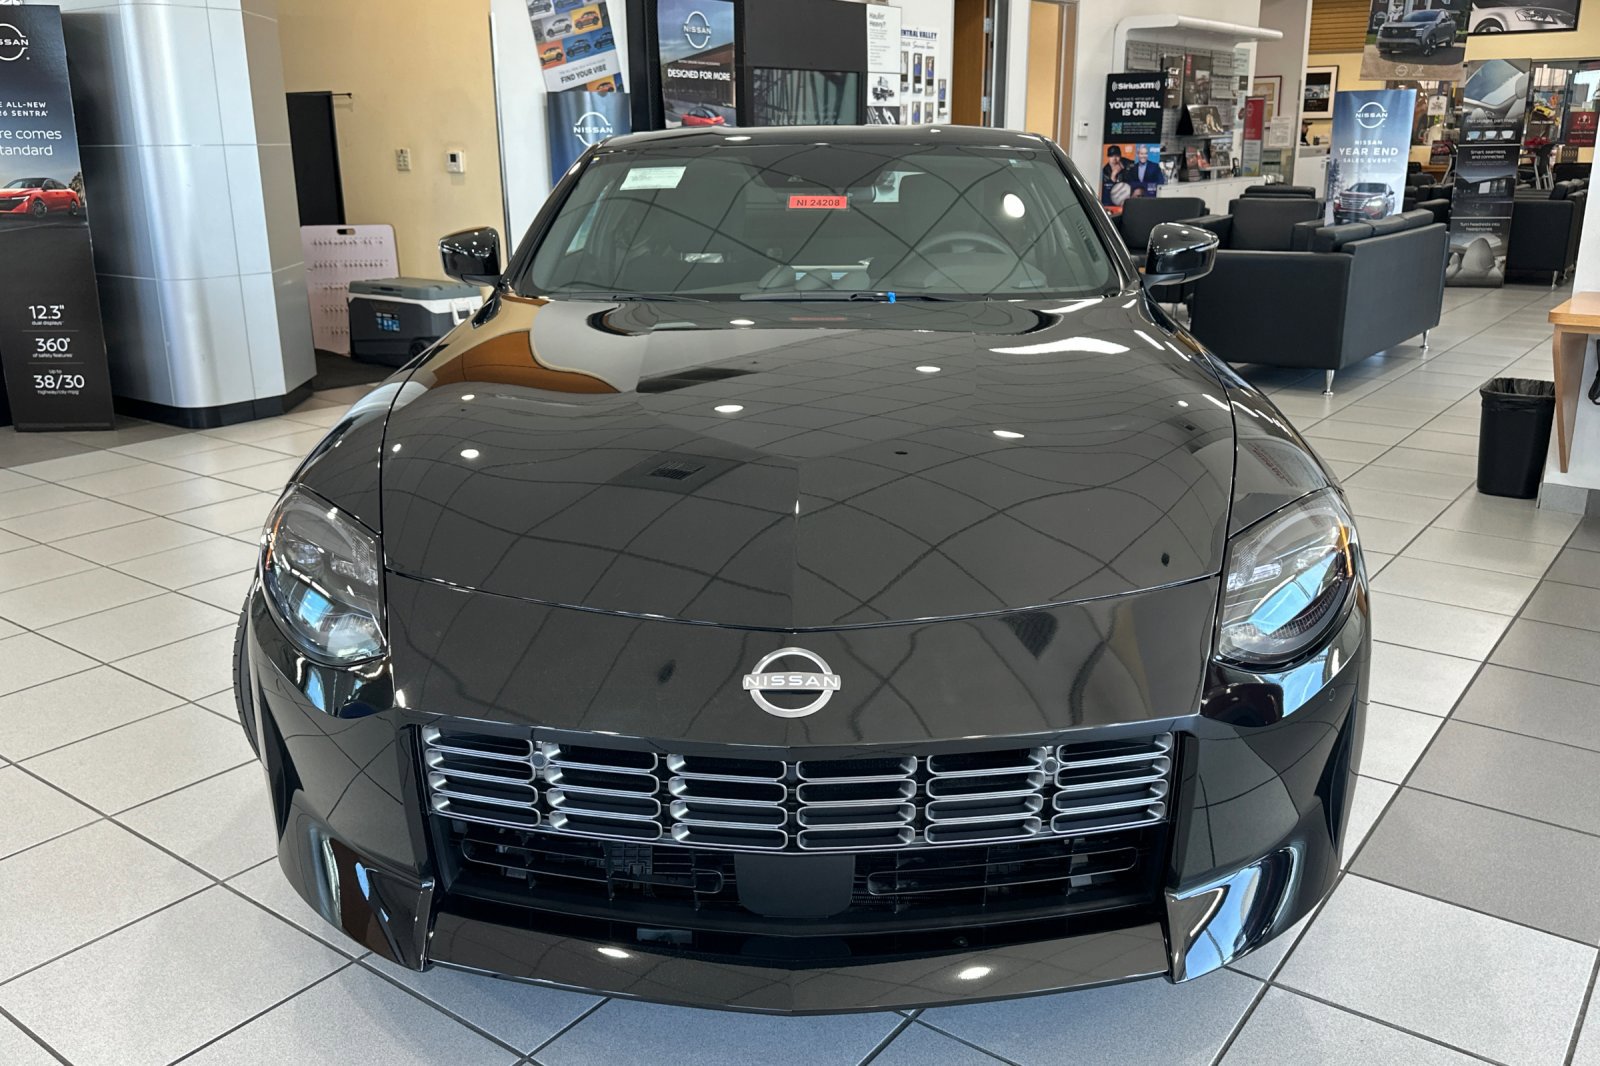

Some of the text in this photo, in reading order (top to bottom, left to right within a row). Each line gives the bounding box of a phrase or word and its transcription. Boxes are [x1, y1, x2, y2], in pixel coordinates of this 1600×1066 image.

[683, 25, 712, 34] NISSAN
[919, 31, 937, 39] VALLEY
[560, 74, 576, 84] FIND
[575, 69, 592, 79] YOUR
[592, 64, 607, 74] VIBE
[667, 69, 731, 81] DESIGNED FOR MORE
[1109, 101, 1161, 109] YOUR TRIAL
[15, 130, 62, 140] comes
[573, 126, 613, 134] NISSAN
[1339, 147, 1399, 156] YEAR END
[796, 199, 840, 207] NI 24208
[28, 305, 65, 319] 12.3"
[35, 338, 71, 352] 360°
[33, 375, 85, 390] 38/30
[745, 675, 838, 688] NISSAN
